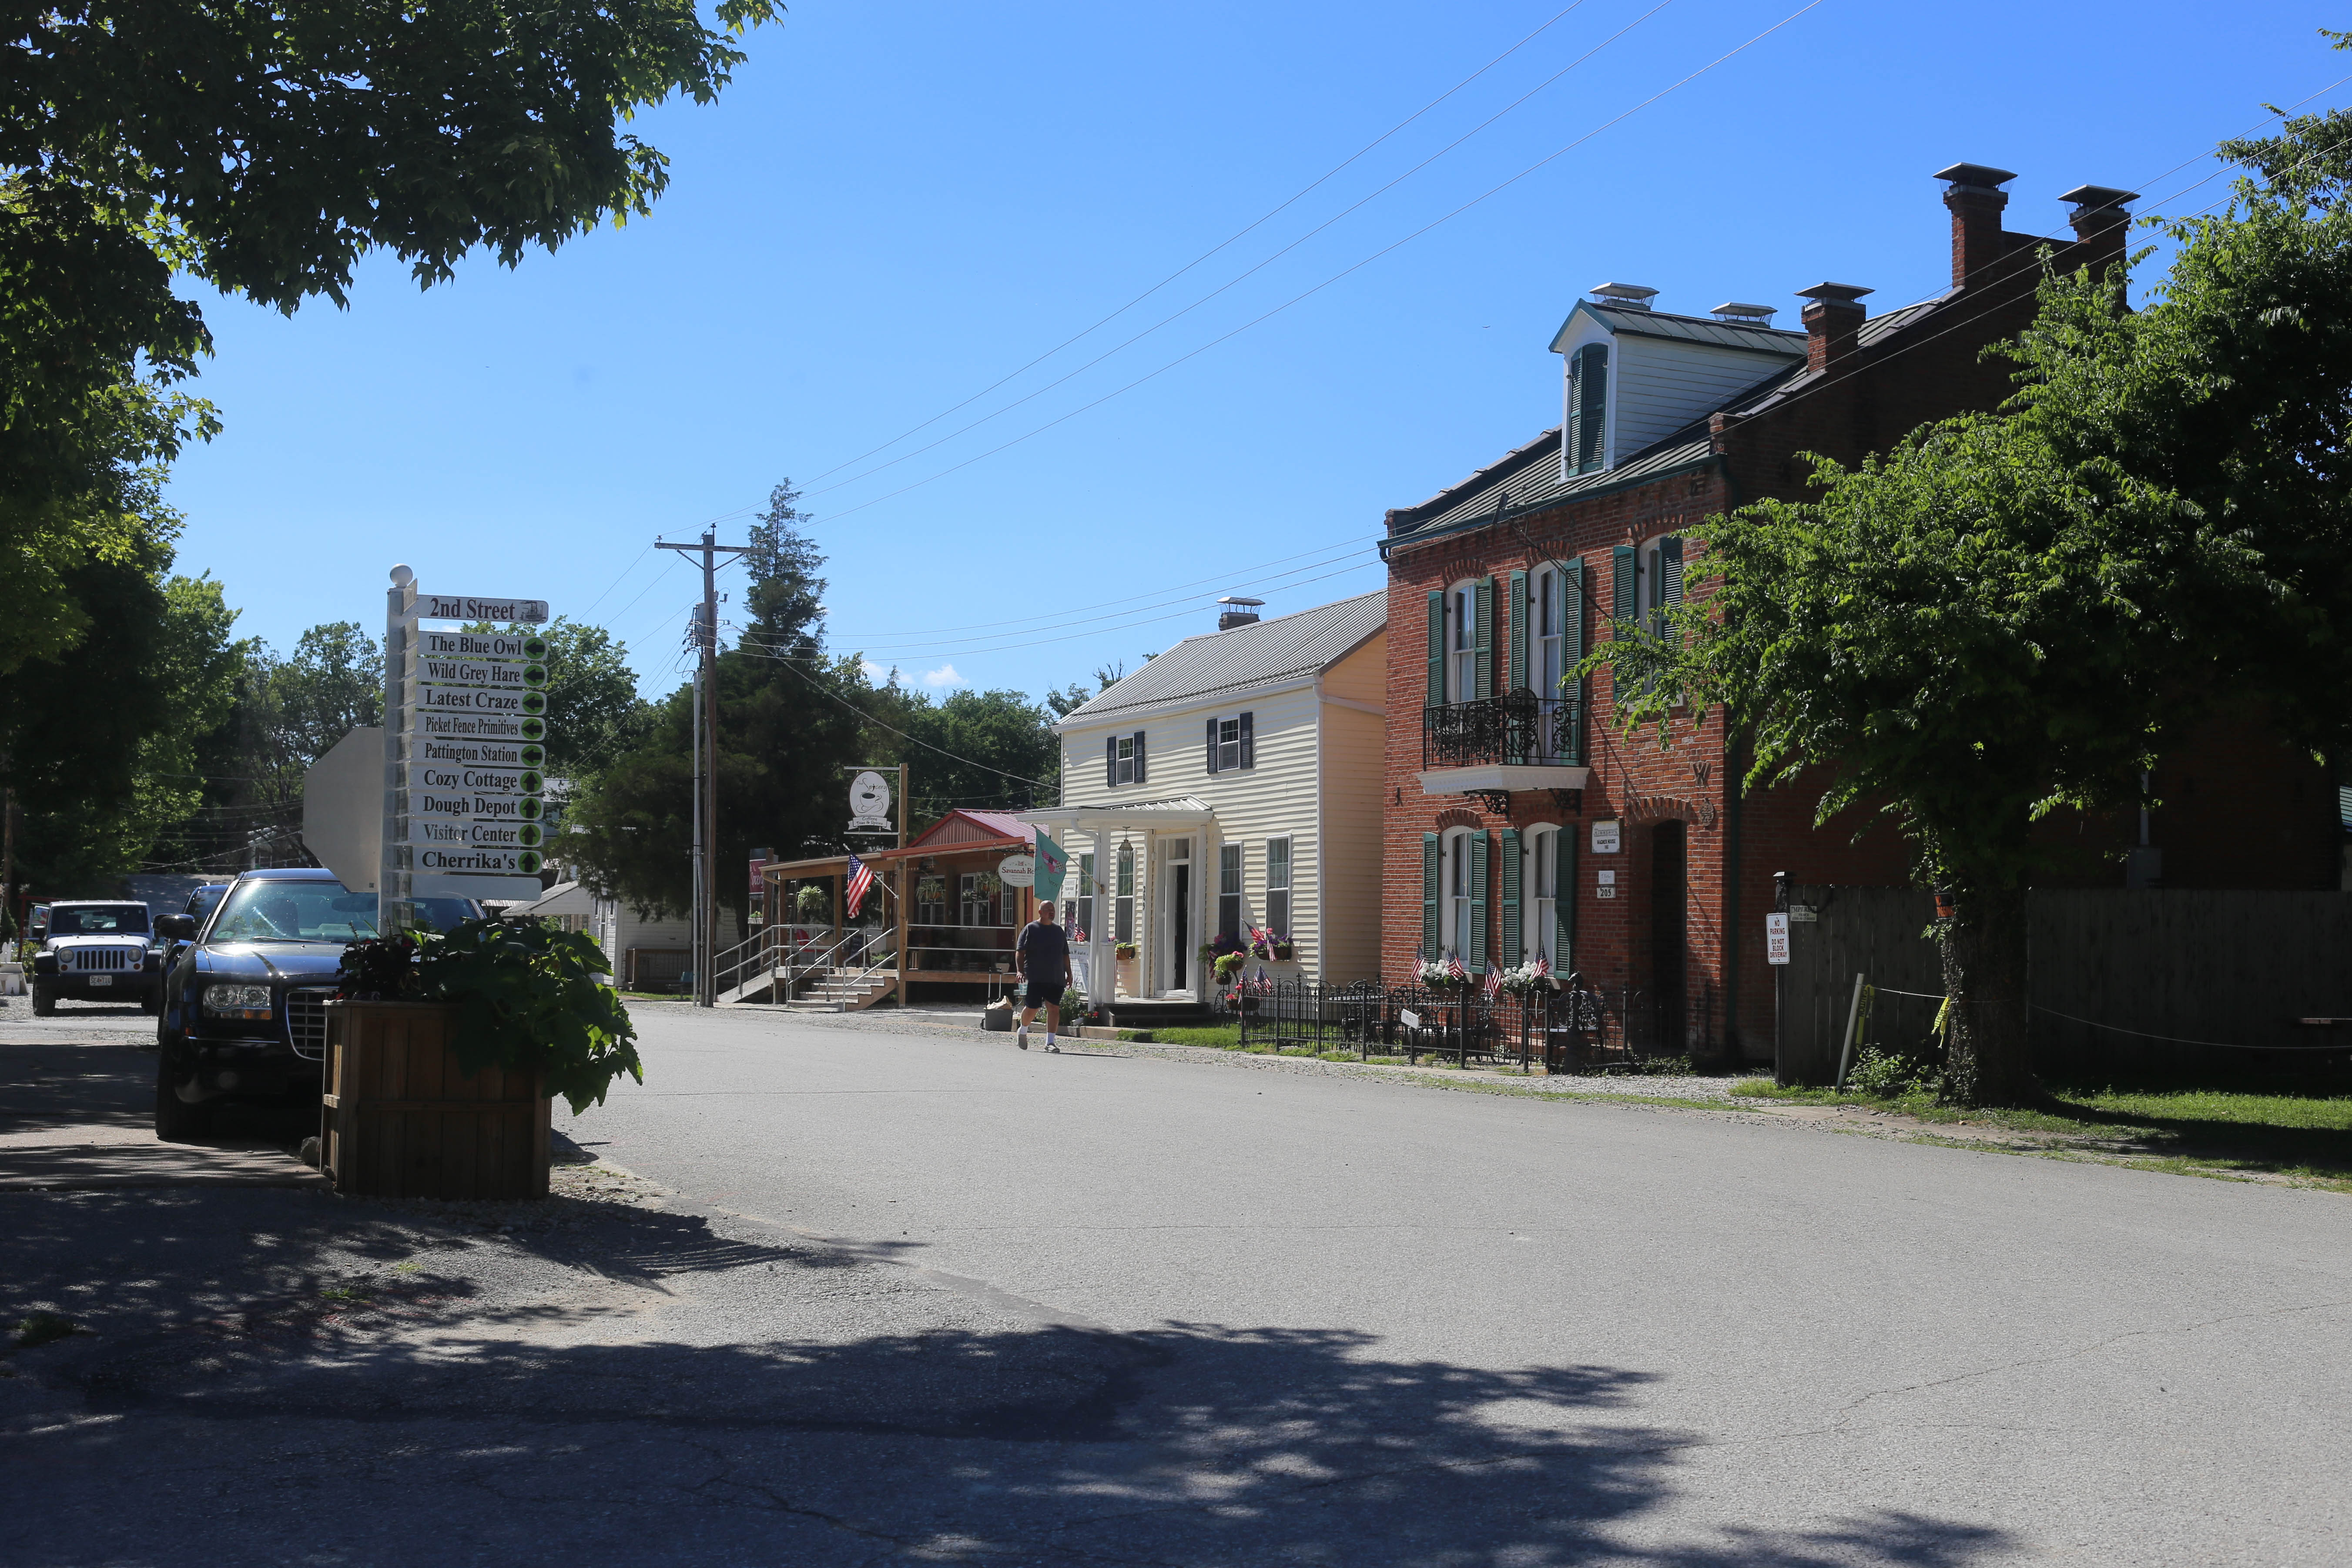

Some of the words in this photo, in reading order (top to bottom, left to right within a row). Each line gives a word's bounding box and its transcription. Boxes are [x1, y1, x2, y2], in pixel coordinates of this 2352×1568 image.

[430, 597, 461, 618] 2nd
[466, 599, 515, 620] Street
[429, 635, 455, 652] The
[459, 637, 489, 653] Blue
[494, 639, 521, 655] Owl
[428, 662, 456, 679] Wild
[459, 664, 488, 684] Grey
[491, 666, 520, 682] Hare
[425, 689, 471, 707] Latest
[475, 692, 518, 709] Craze
[426, 717, 451, 732] Picket
[452, 718, 476, 734] Fence
[478, 718, 518, 735] Primitives
[425, 743, 478, 763] Pattington
[481, 745, 517, 762] Station
[424, 769, 459, 789] Cozy
[464, 771, 517, 791] Cottage
[422, 796, 470, 816] Dough
[474, 797, 516, 817] Depot
[423, 824, 468, 840] Visitor
[472, 825, 516, 842] Center
[422, 851, 516, 870] Cherrika's
[1600, 888, 1612, 897] 205
